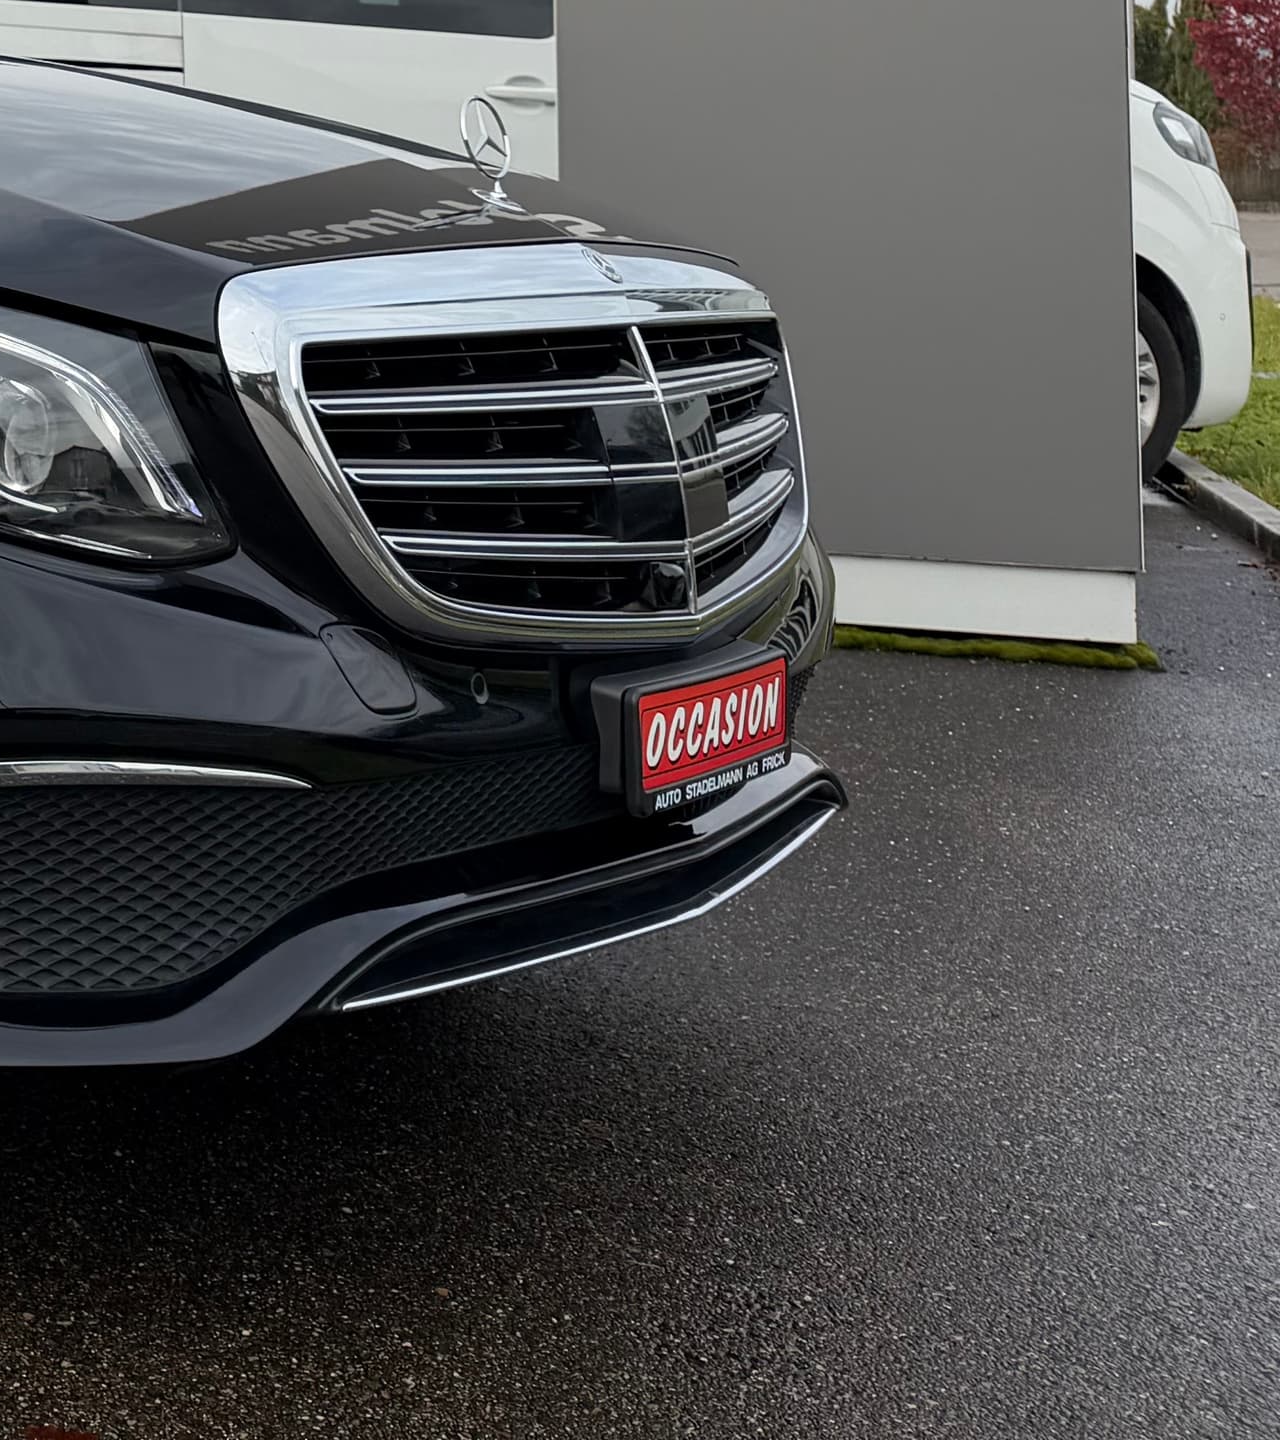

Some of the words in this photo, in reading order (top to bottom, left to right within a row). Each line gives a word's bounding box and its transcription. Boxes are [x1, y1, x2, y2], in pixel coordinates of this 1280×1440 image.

[646, 675, 780, 768] OCCASION
[655, 788, 682, 811] AUTO
[685, 766, 743, 800] STADELMANN
[746, 761, 759, 779] AG
[762, 751, 786, 773] FRICK
